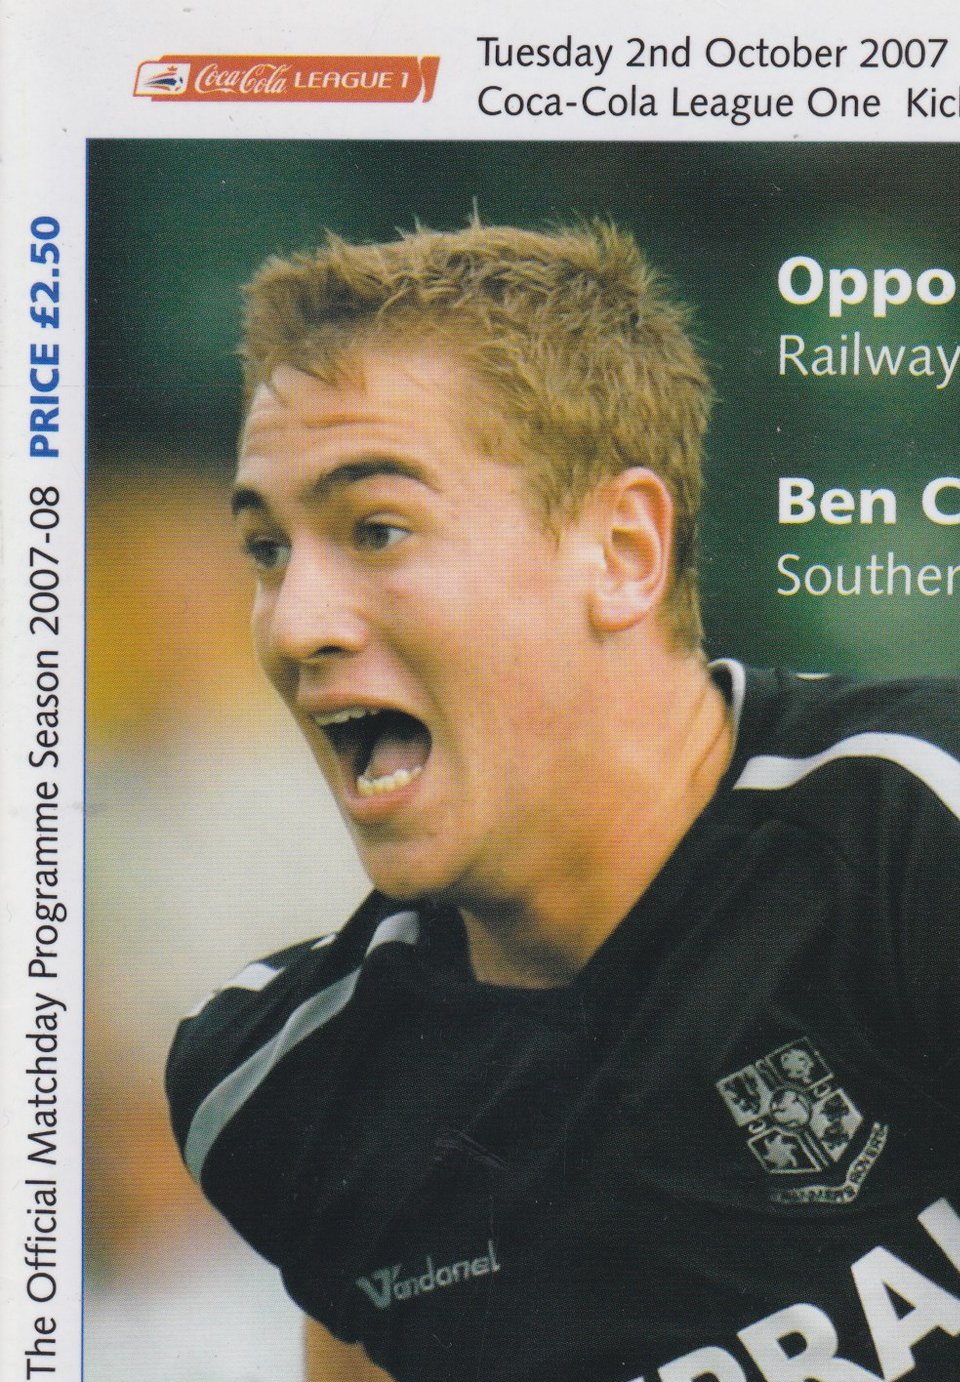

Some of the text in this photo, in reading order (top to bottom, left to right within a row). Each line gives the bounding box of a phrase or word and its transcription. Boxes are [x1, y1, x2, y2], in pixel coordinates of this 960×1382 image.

[476, 34, 949, 77] Tuesday 2nd October 2007
[294, 72, 393, 88] LEAGUE
[401, 72, 408, 88] 1
[477, 84, 659, 117] Coca-Cola
[672, 86, 794, 127] League
[807, 86, 881, 118] One
[778, 477, 897, 524] Ben
[24, 216, 68, 1381] The Official Matchday Programme Season 2007-08 PRICE £2.50
